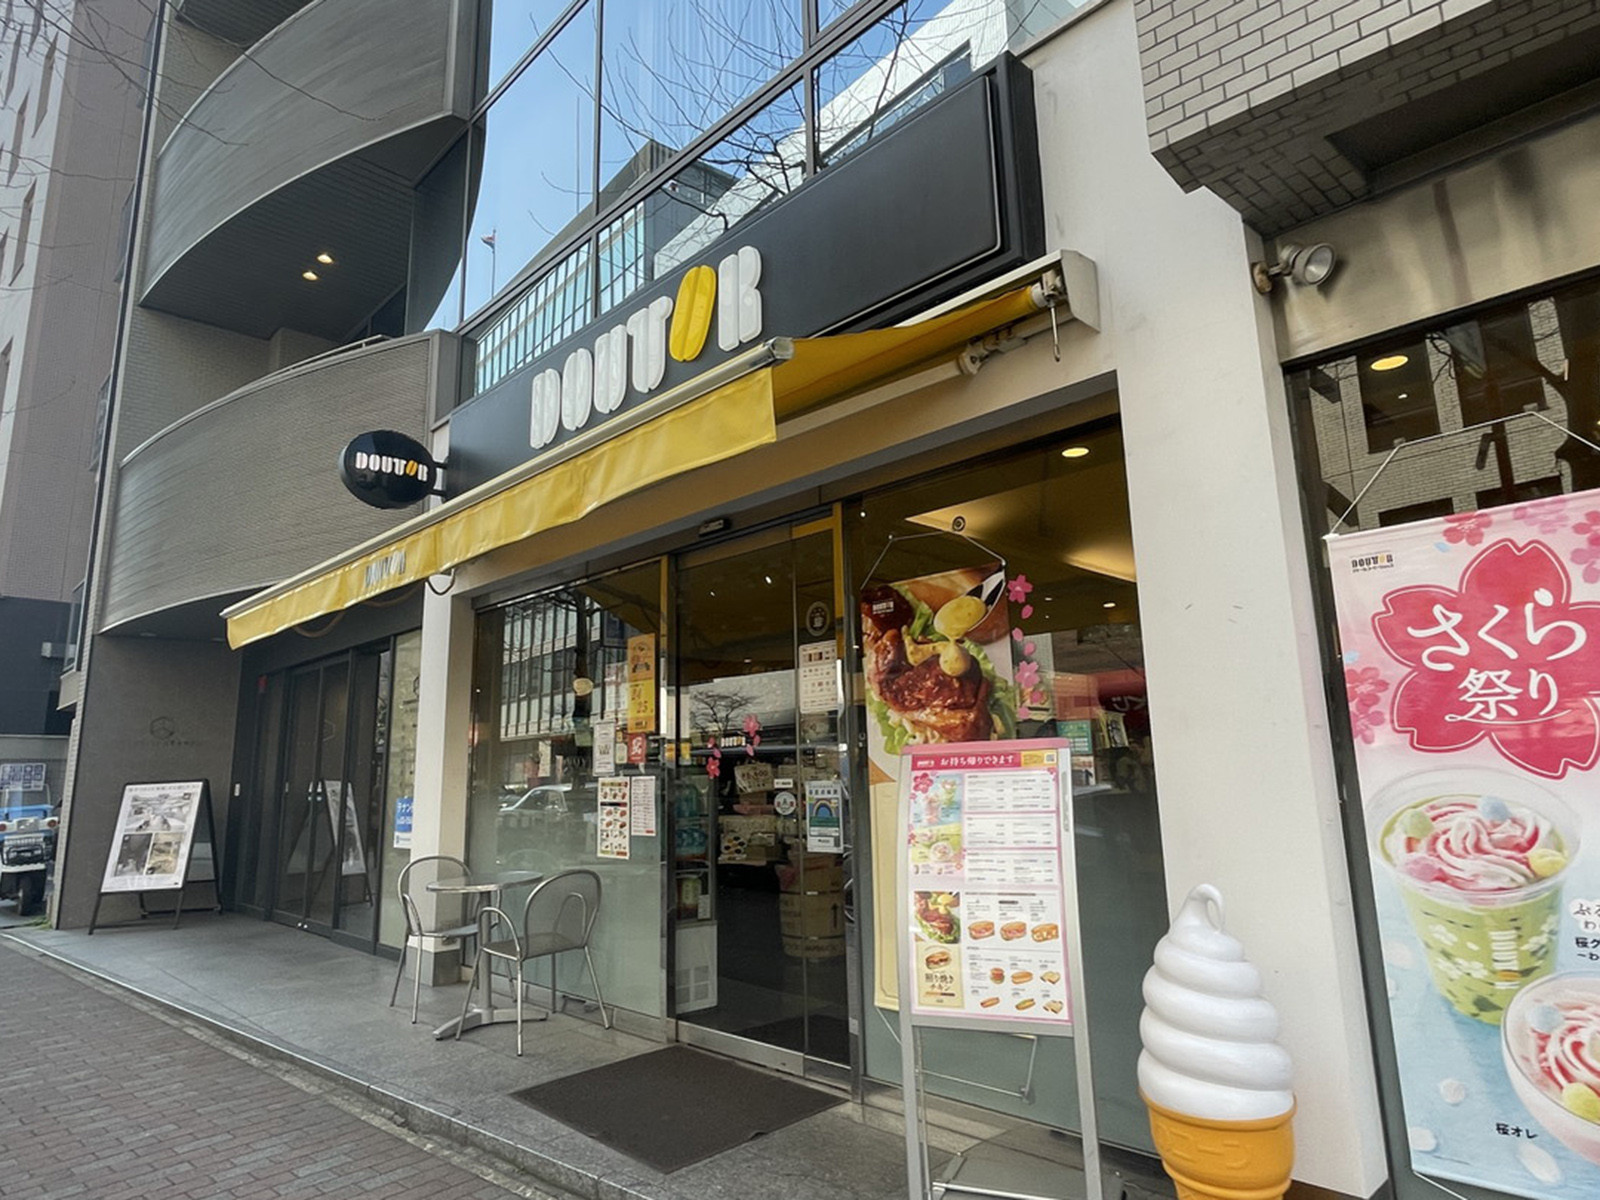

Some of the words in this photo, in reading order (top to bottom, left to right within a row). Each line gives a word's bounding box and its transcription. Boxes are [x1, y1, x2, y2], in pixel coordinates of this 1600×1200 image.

[530, 245, 762, 449] DOUTOR
[355, 452, 428, 482] DOUTOR
[1407, 588, 1587, 671] さくら
[1452, 667, 1563, 722] 祭り
[940, 755, 1014, 766] お持ち帰りできます
[1495, 1122, 1539, 1139] 桜オレ
